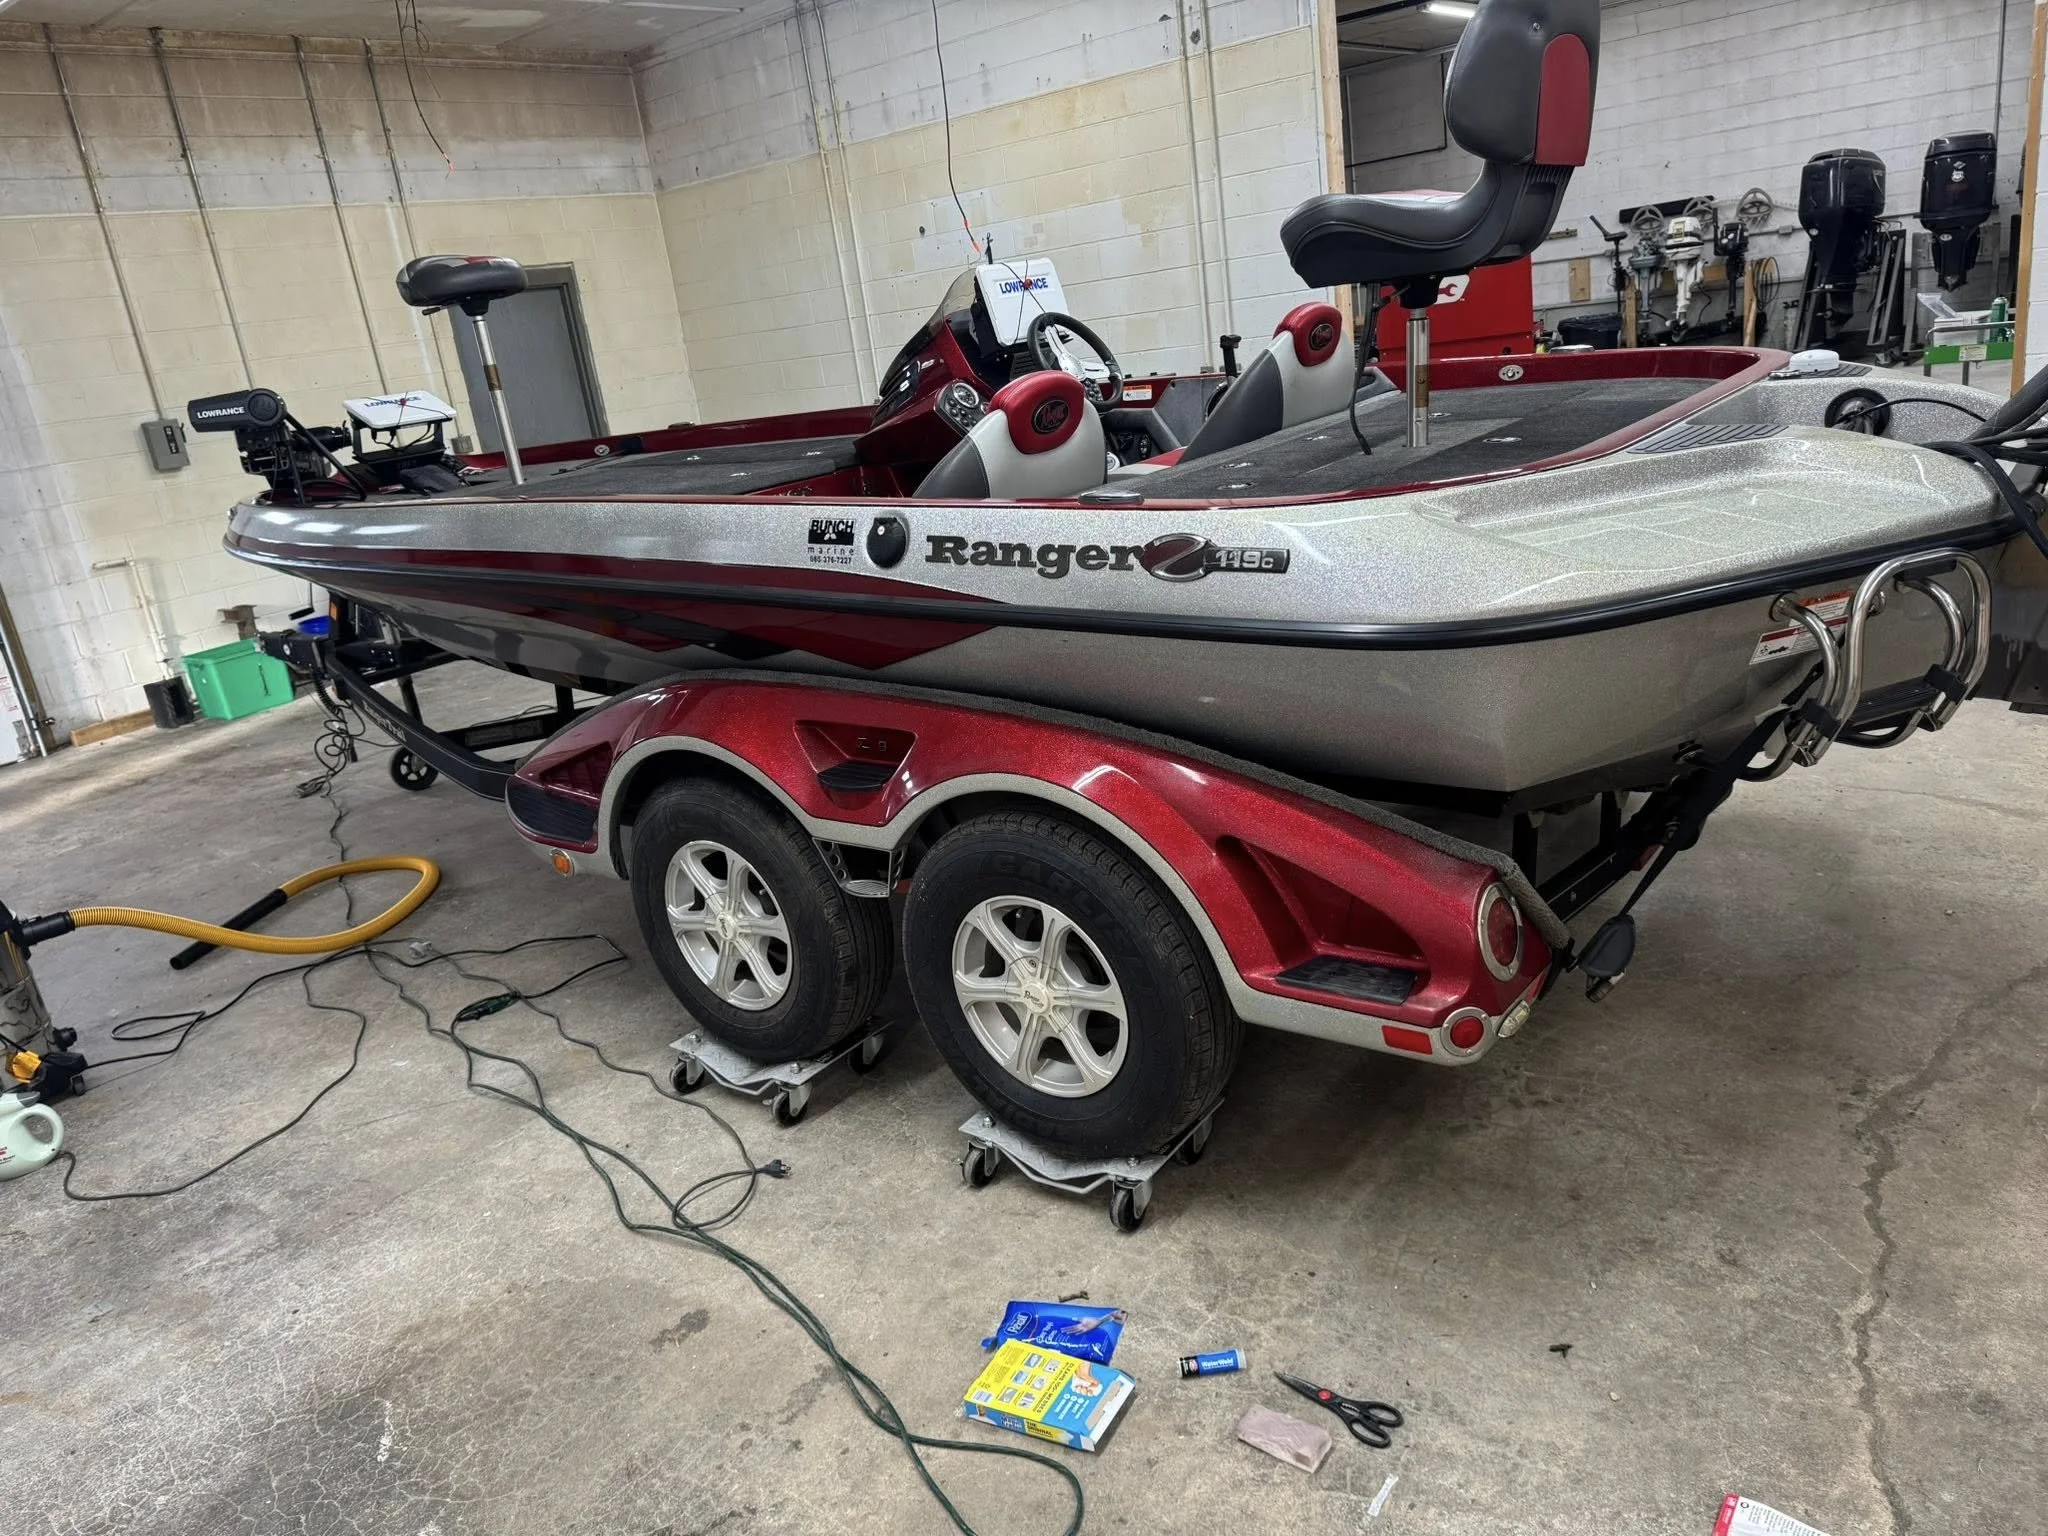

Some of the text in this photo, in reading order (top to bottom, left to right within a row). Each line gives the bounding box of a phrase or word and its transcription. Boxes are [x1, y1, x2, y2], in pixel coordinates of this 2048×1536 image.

[197, 406, 245, 419] LOWRANCE
[811, 519, 854, 533] BUNCH
[807, 546, 854, 556] marine
[924, 535, 1143, 578] Ranger
[1215, 550, 1274, 569] 119c
[1036, 1391, 1054, 1414] MESSES
